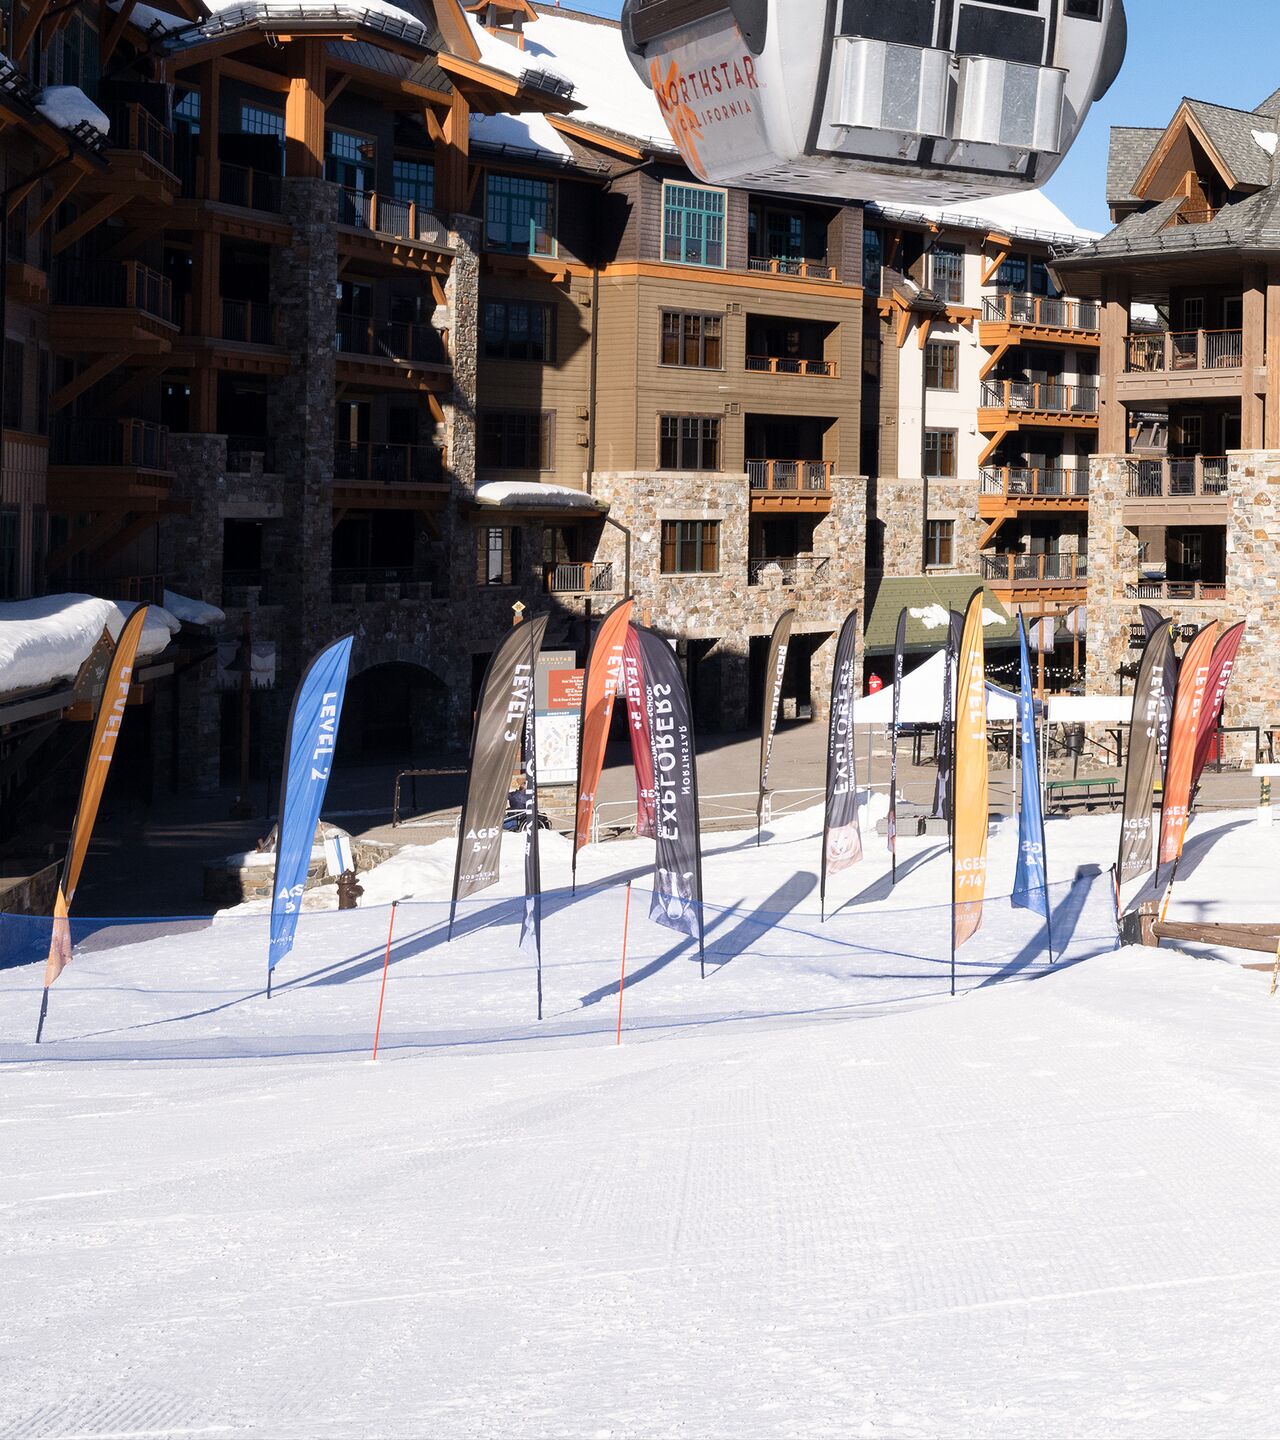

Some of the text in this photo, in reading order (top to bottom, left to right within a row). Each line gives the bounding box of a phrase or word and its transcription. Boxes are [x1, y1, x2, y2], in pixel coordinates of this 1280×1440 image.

[656, 56, 758, 111] NORTHSTAR
[680, 100, 752, 131] CALIFORNIA
[507, 664, 531, 723] LEVEL
[969, 651, 985, 740] LEVEL 1
[1147, 665, 1163, 720] LEVEL
[1192, 666, 1209, 718] LEVEL
[1213, 660, 1233, 706] LEVEL
[311, 691, 337, 780] LEVEL 2
[504, 730, 518, 742] 3
[1123, 818, 1150, 829] AGES
[955, 857, 986, 871] AGES
[958, 874, 982, 888] 7-14
